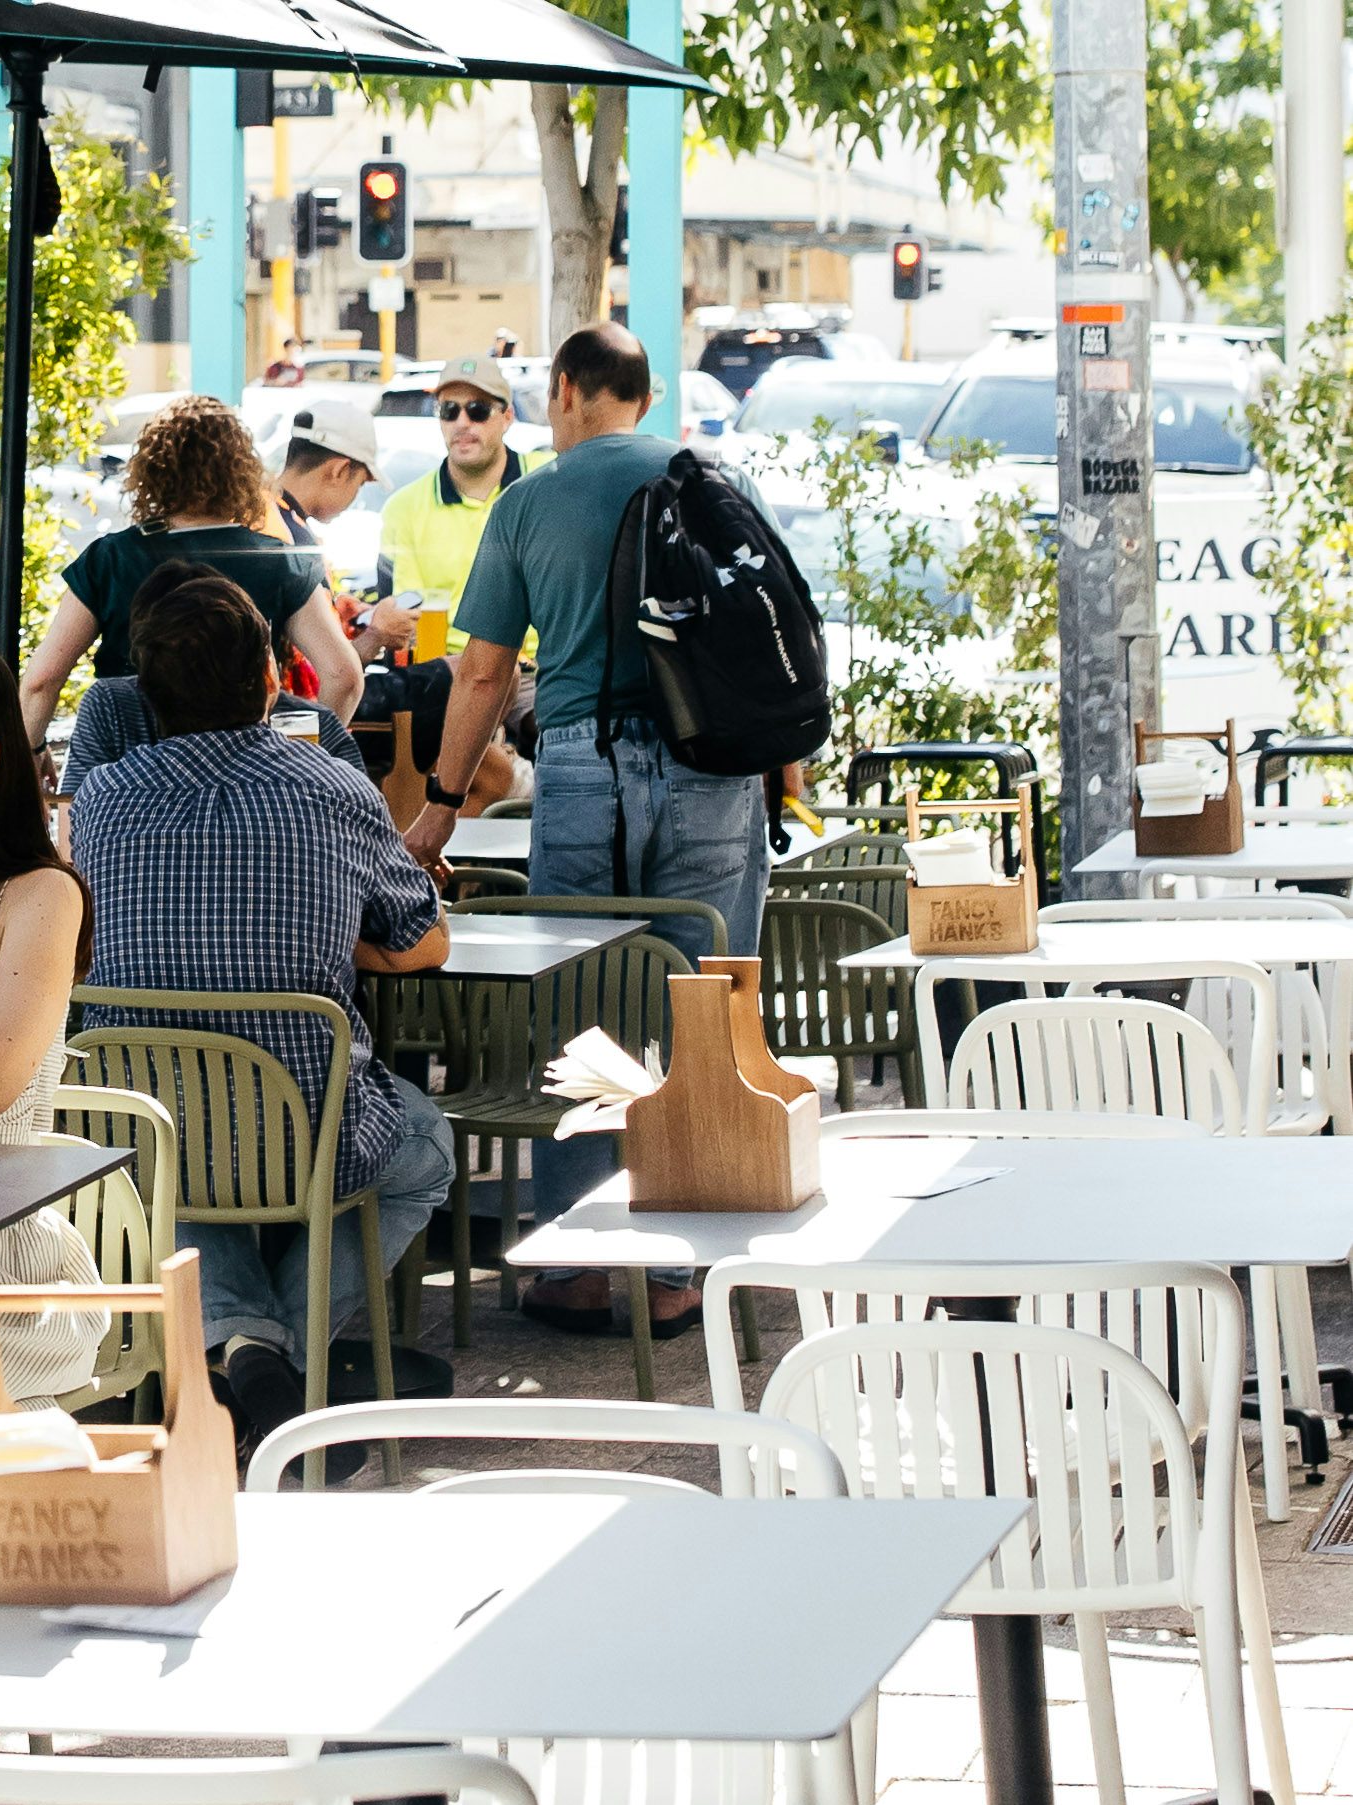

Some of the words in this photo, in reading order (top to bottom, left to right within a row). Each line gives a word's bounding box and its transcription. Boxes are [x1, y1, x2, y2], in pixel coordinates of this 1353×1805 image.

[756, 586, 778, 628] UNDER
[773, 629, 799, 684] ARMOUR
[929, 899, 999, 920] FANCY
